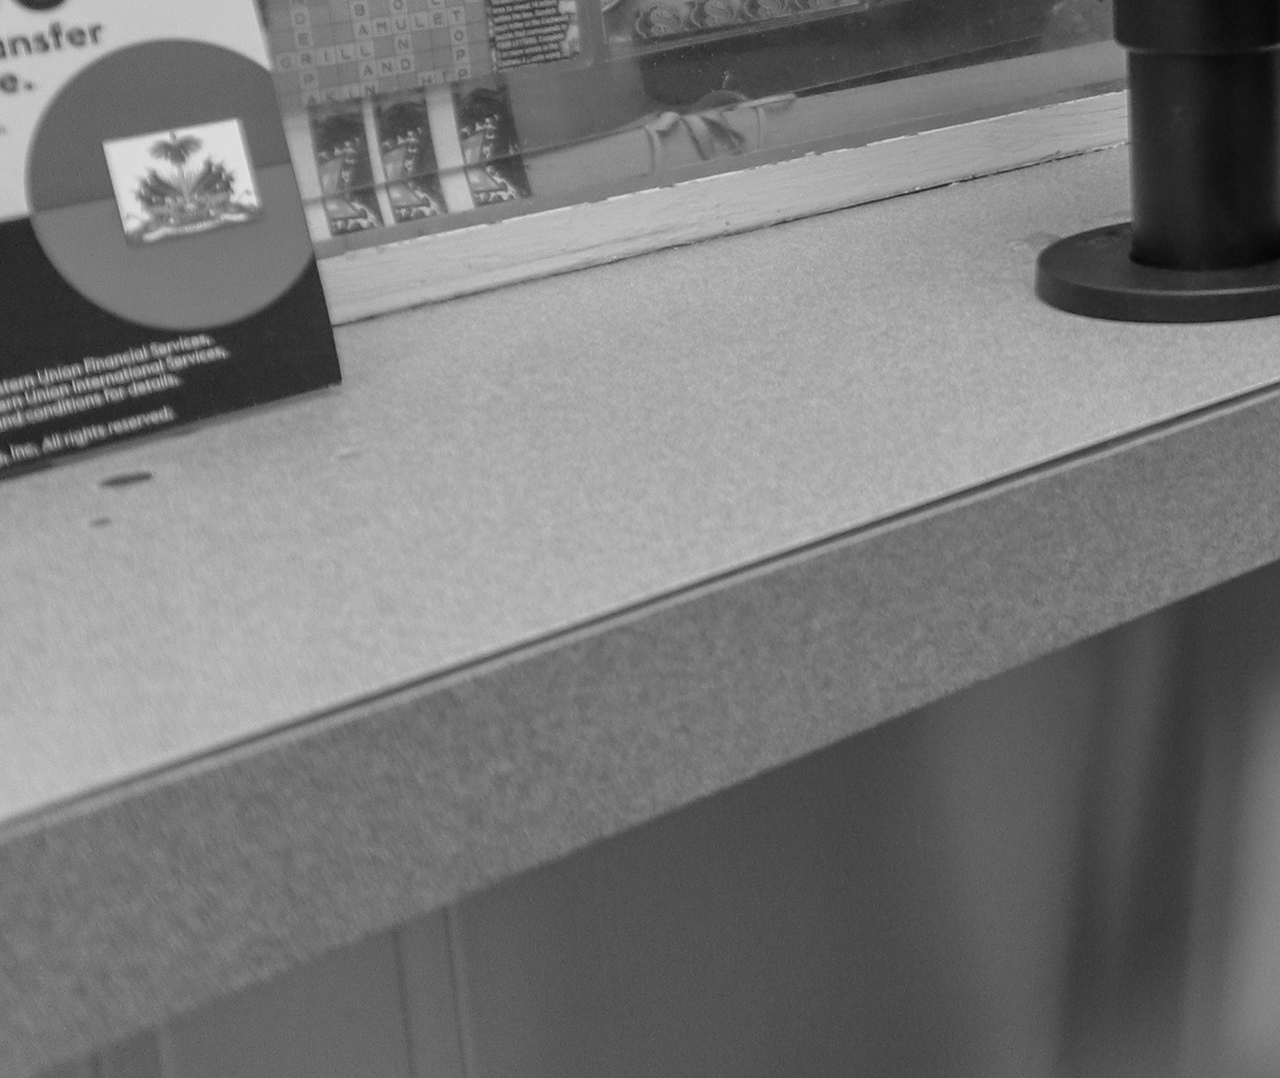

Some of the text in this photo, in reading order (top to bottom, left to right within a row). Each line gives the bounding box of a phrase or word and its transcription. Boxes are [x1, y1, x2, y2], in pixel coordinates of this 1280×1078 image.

[83, 345, 149, 372] Financial
[71, 359, 165, 392] International
[103, 386, 126, 404] for
[42, 432, 63, 453] All
[63, 424, 108, 448] rights
